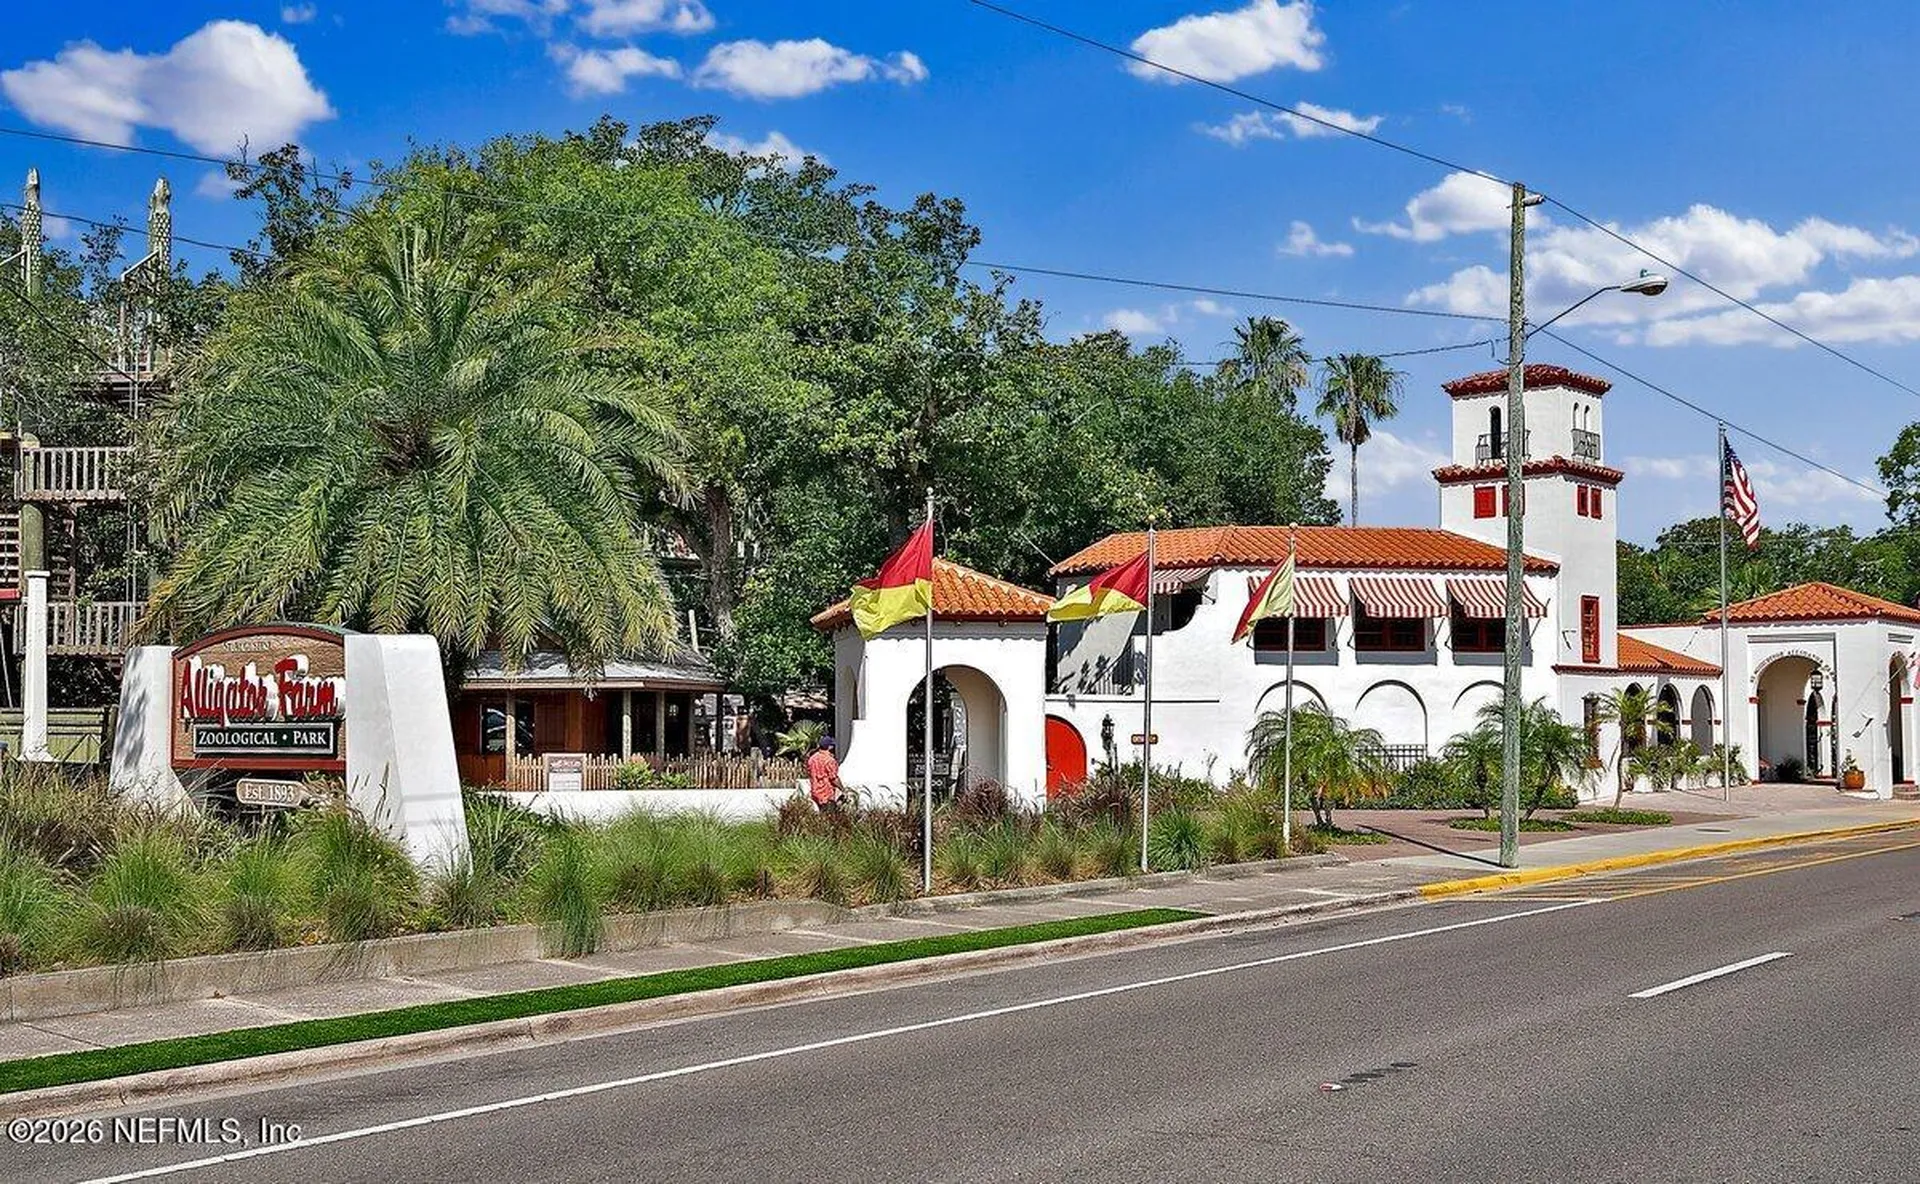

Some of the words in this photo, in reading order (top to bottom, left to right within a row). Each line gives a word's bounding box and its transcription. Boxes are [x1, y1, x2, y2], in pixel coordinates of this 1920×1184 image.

[181, 656, 278, 728] Alligator
[275, 654, 346, 720] Farm
[199, 731, 278, 745] ZOOLOGICAL
[293, 731, 326, 745] PARK
[268, 784, 294, 802] 1893
